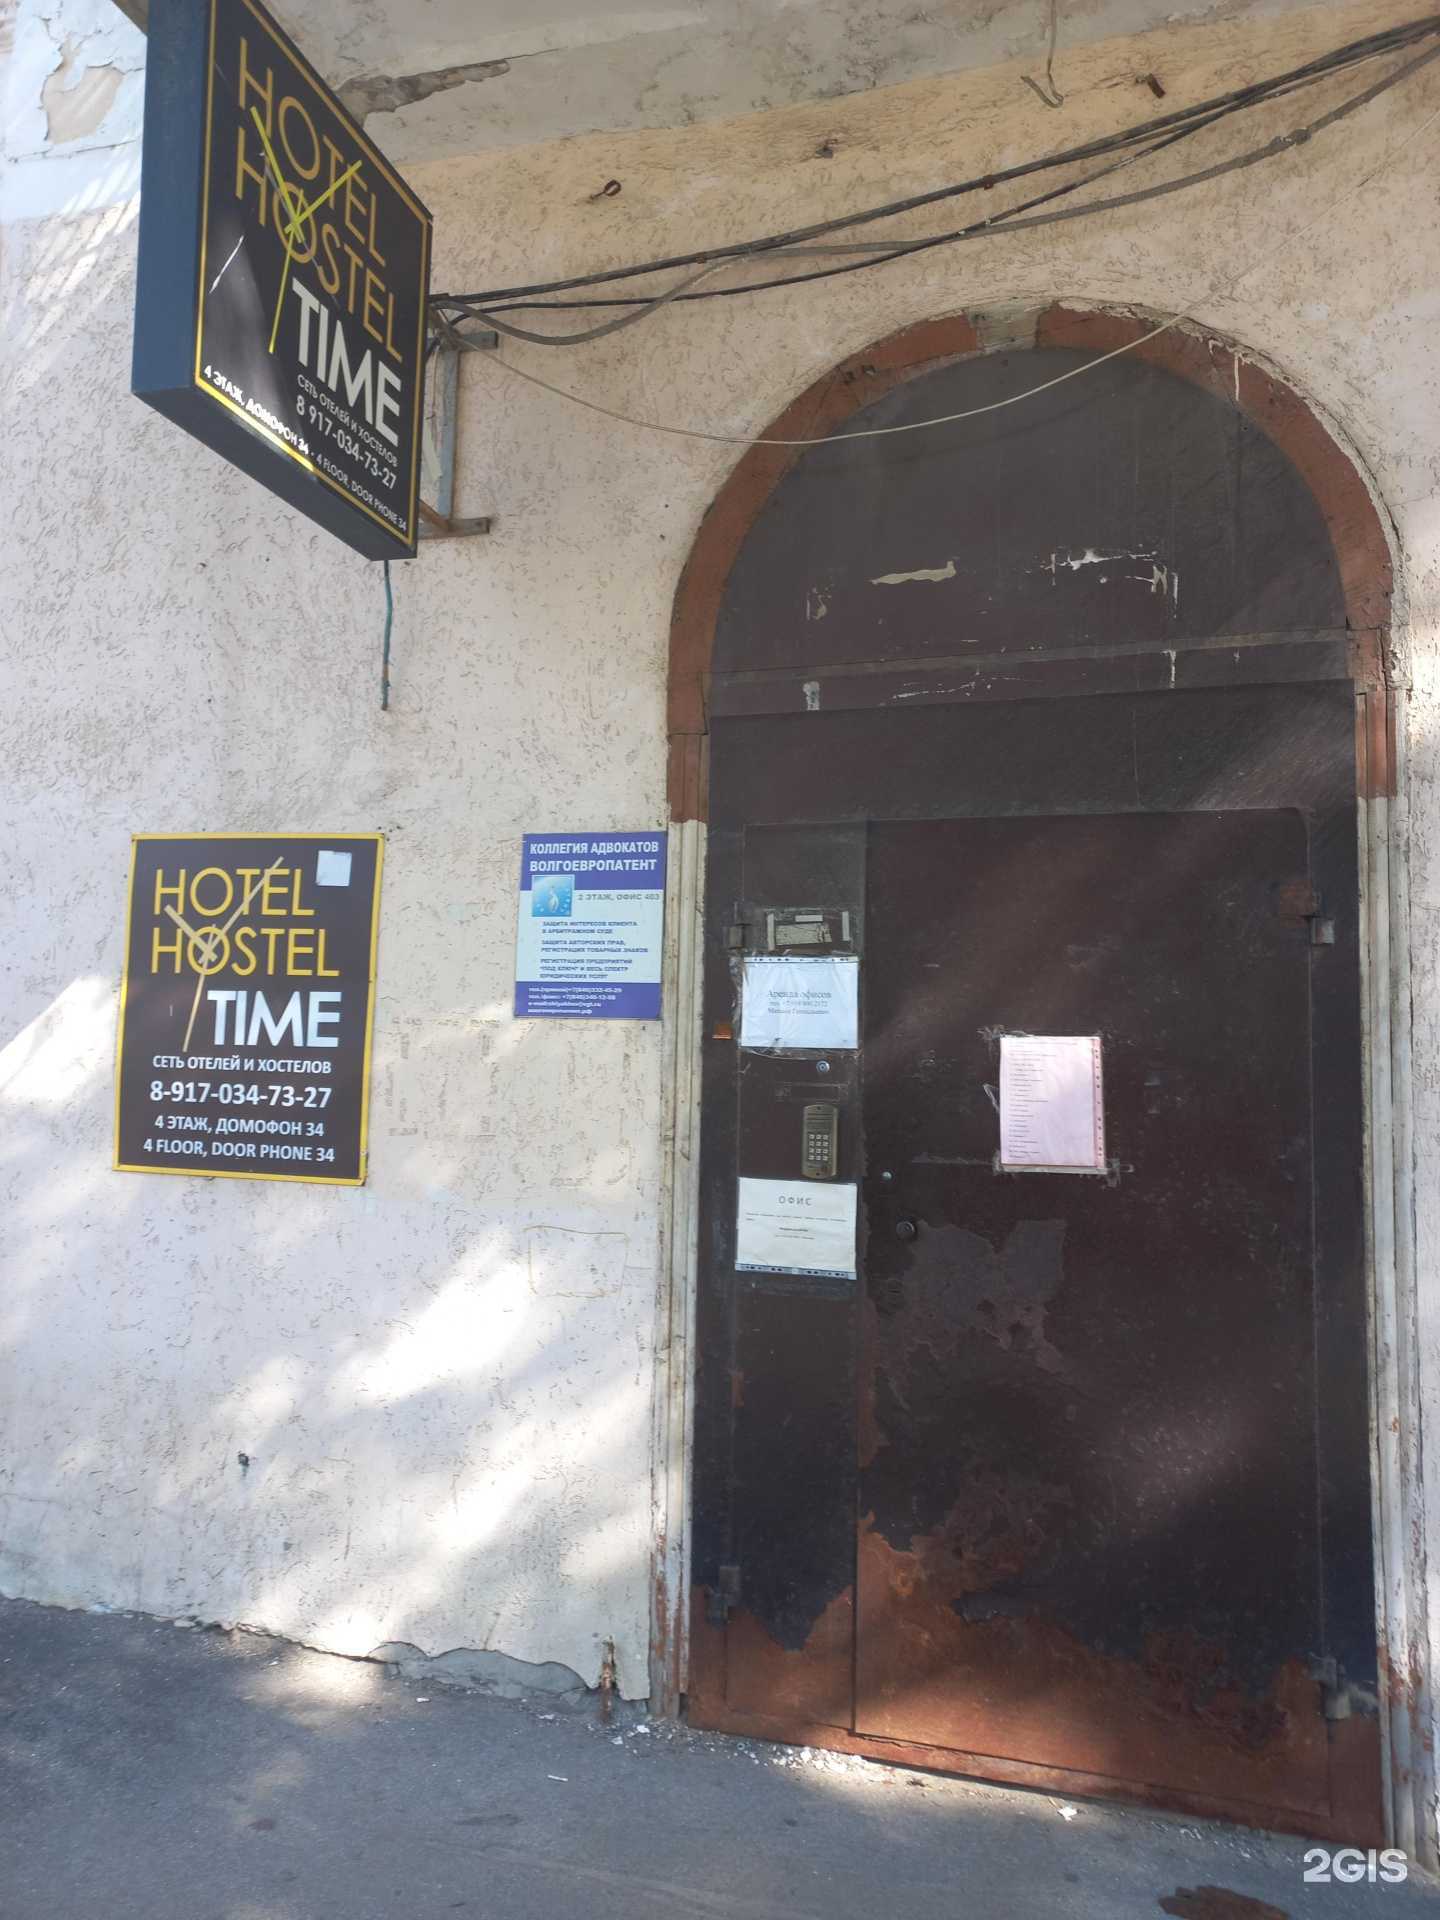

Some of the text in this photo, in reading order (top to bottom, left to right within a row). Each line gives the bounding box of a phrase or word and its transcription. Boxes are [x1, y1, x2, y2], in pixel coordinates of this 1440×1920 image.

[240, 37, 386, 267] HOTEL
[235, 126, 403, 363] HOSTEL
[204, 365, 212, 379] 4
[292, 277, 402, 447] TIME
[297, 374, 398, 467] СЕТЬ ОТЕЛЕЙ И ХОСТЕЛОВ
[351, 480, 373, 504] DOOR
[374, 498, 397, 523] PHONE
[530, 841, 659, 855] КОЛЛЕГИЯ АДВОКАТОВ
[529, 859, 657, 872] ВОЛГОЕВРОПАТЕНТ
[153, 867, 315, 916] HOTEL
[616, 893, 642, 901] ОФИС
[151, 926, 340, 977] HOSTEL
[207, 990, 342, 1048] TIME
[152, 1055, 332, 1074] СЕТЬ ОТЕЛЕЙ И ХОСТЕЛОВ
[150, 1080, 332, 1108] 8-917-034-73-27
[154, 1115, 324, 1137] 4 ЭТАЖ, ДОМОФОН 34
[143, 1138, 335, 1162] 4 FLOOR, DOOR PHONE 34
[778, 1195, 813, 1206] ОФИС
